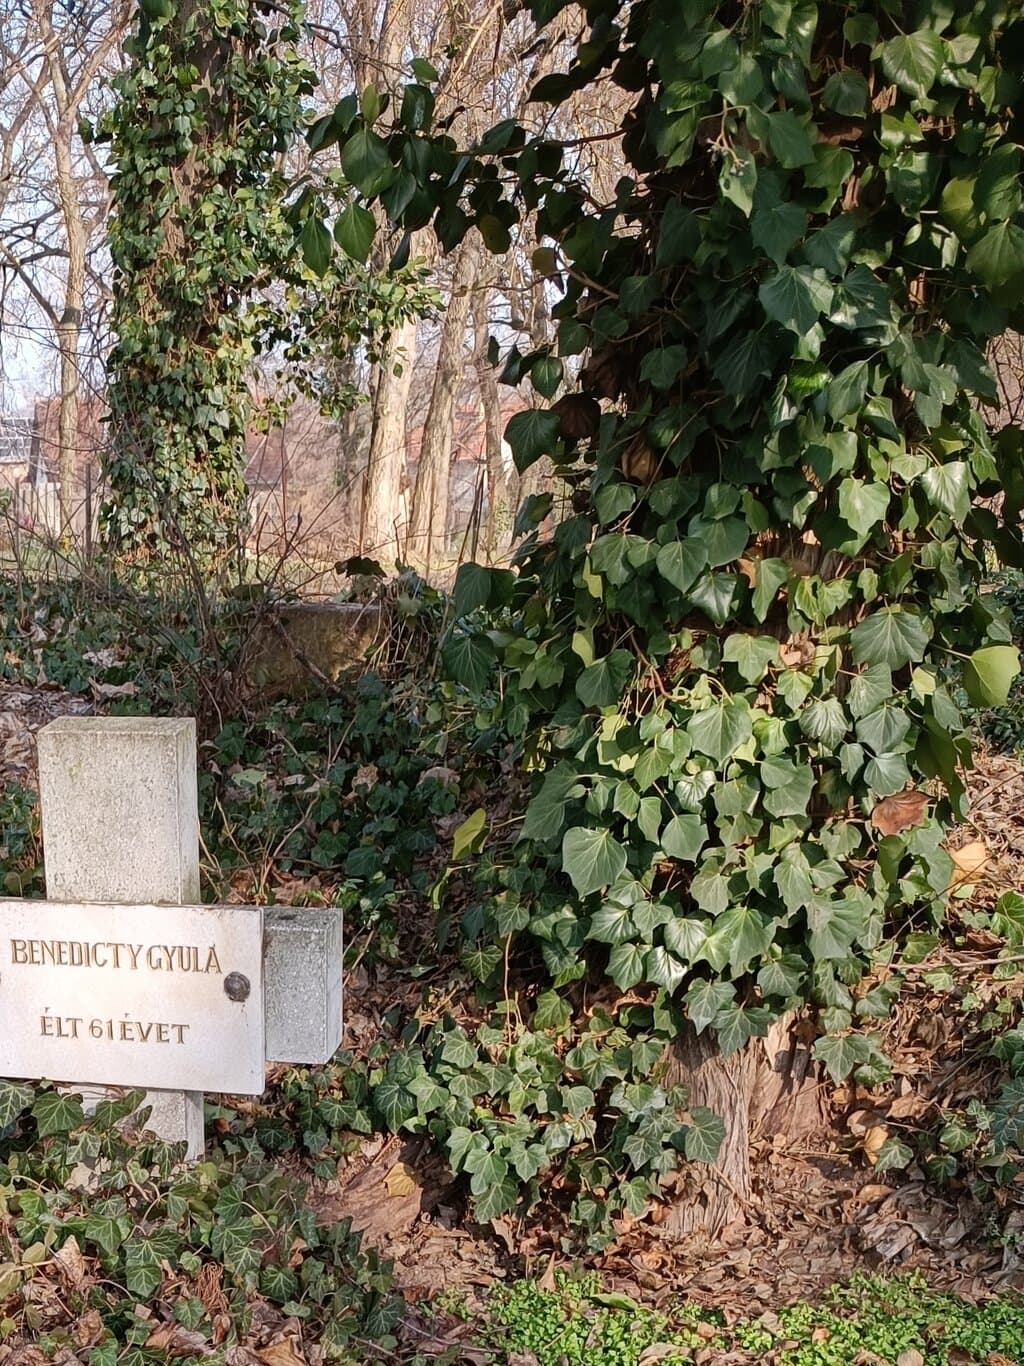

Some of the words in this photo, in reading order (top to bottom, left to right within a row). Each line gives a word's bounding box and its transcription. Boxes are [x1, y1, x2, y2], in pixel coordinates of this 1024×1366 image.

[10, 939, 144, 969] BENEDICTY
[40, 1006, 83, 1038] ÉLT
[88, 1019, 114, 1040] 61
[119, 1012, 191, 1044] ÉVET
